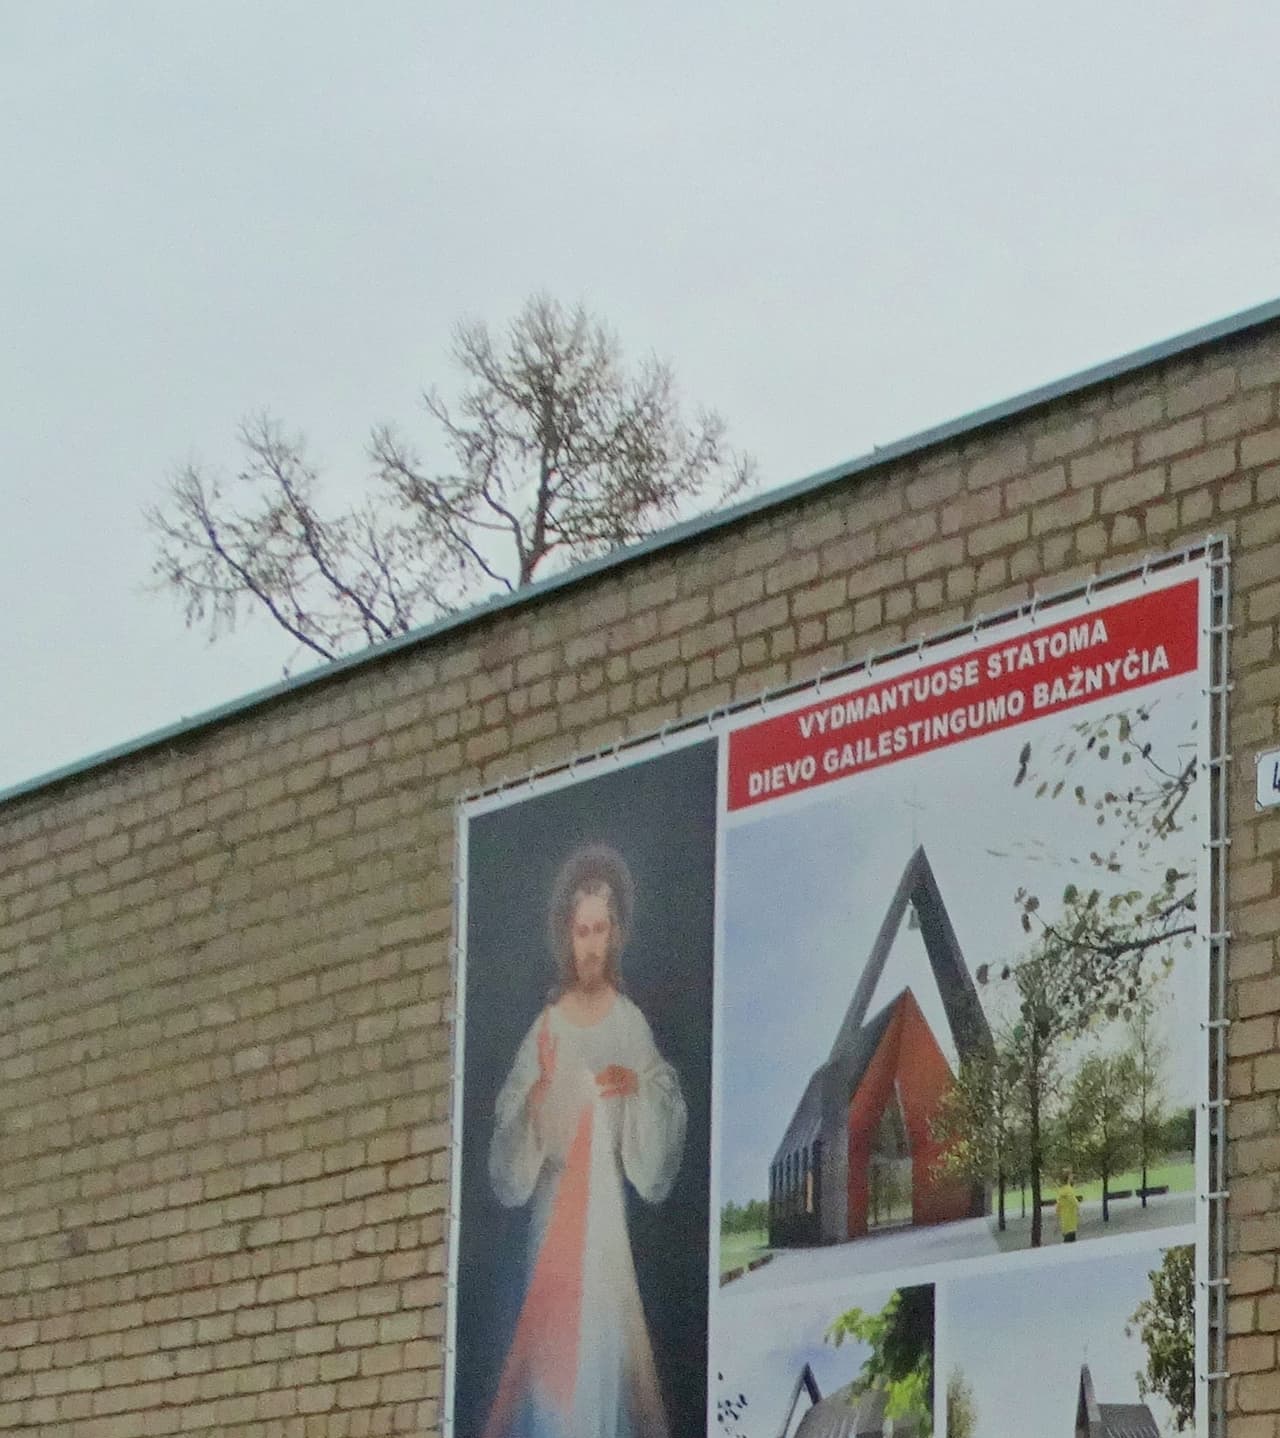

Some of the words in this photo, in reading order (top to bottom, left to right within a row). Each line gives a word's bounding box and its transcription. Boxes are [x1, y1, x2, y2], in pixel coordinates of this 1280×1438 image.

[748, 755, 816, 797] DIEVO
[823, 690, 1025, 774] GAILESTINGUMO
[1032, 645, 1169, 707] BAŽNYČIA
[798, 660, 979, 739] VYDMANTUOSE
[987, 619, 1108, 675] STATOMA
